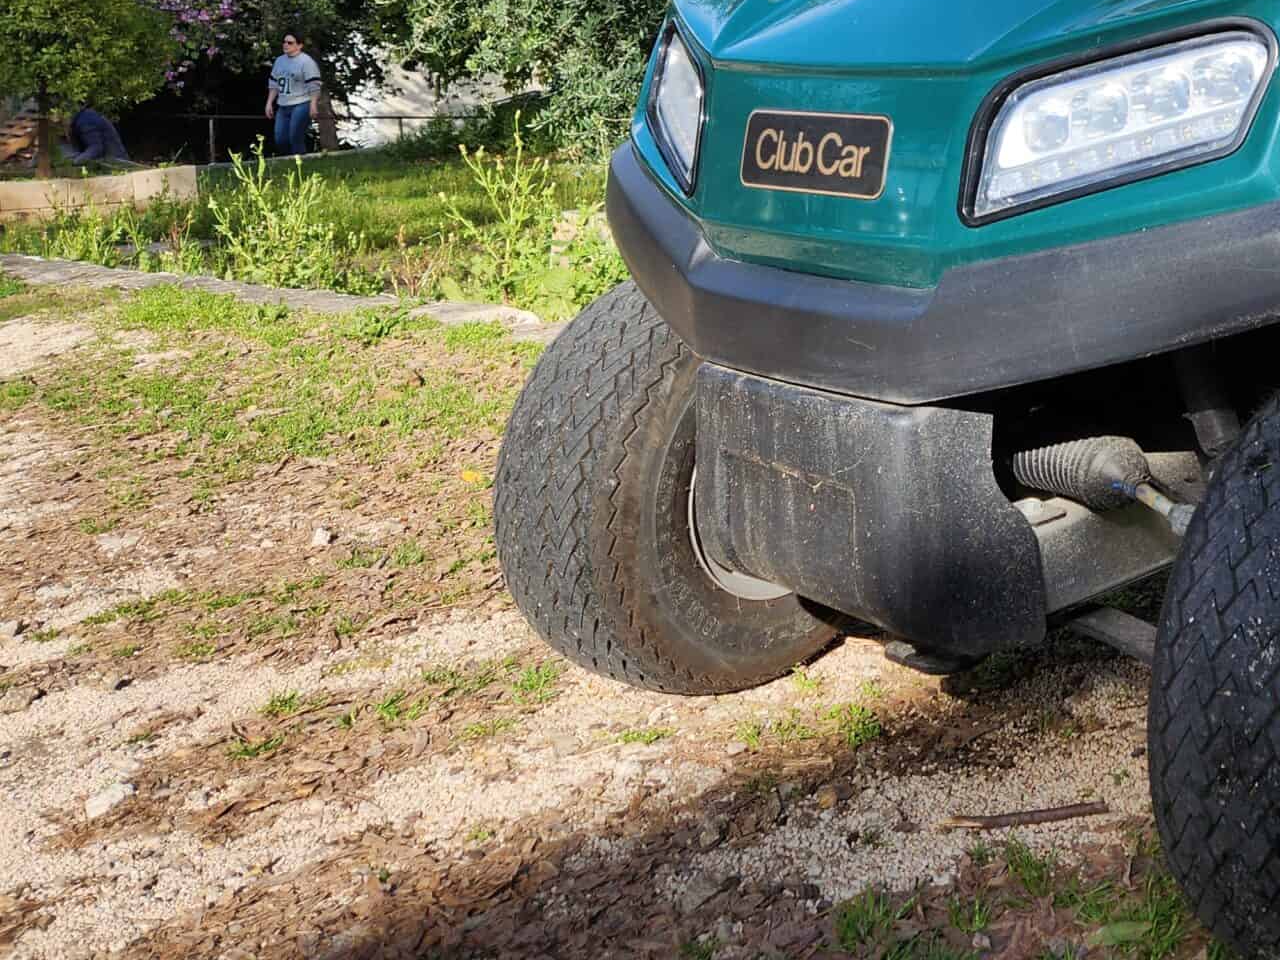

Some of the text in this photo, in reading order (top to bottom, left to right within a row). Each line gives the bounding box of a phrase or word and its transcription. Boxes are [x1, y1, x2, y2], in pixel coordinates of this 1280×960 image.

[278, 77, 291, 95] 91
[755, 127, 870, 178] Club Car
